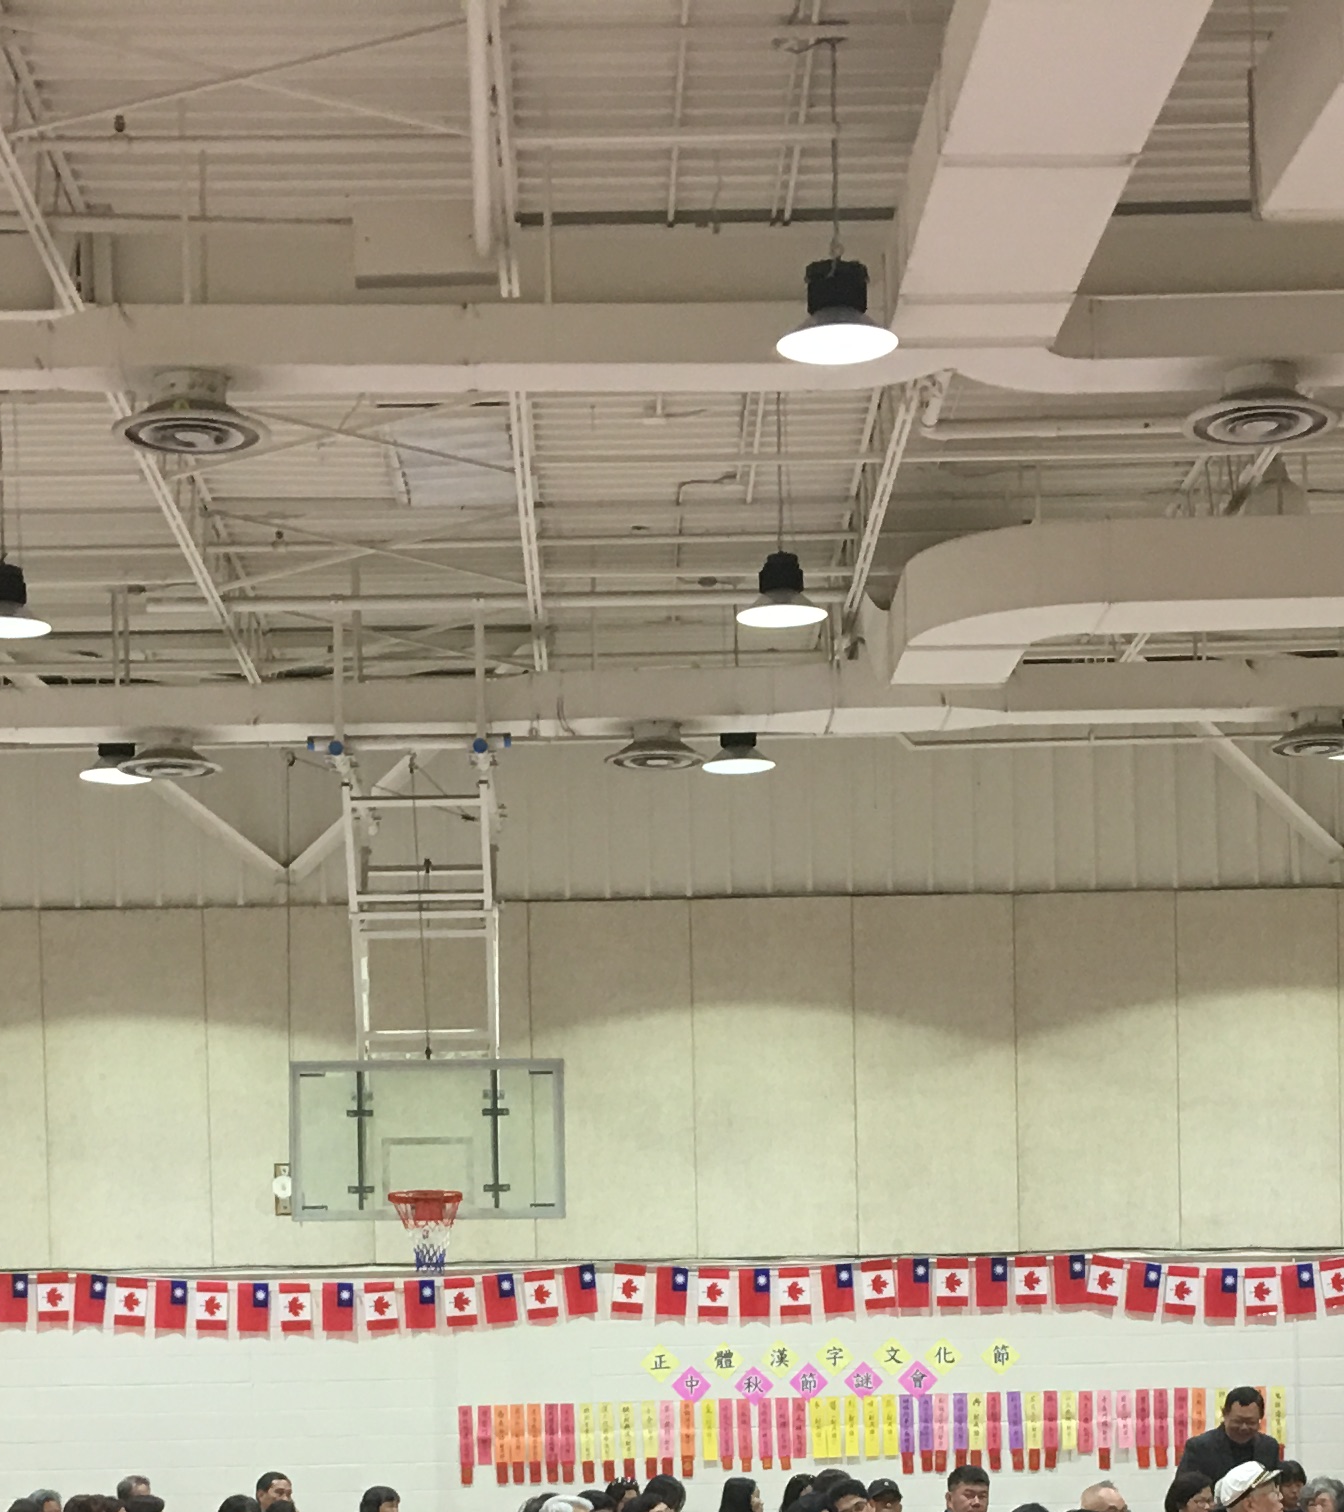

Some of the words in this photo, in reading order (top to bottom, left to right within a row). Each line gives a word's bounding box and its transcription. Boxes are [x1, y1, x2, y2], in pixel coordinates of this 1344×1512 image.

[650, 1344, 1009, 1370] 正體漢字文化節
[685, 1369, 928, 1394] 中秋節謎會
